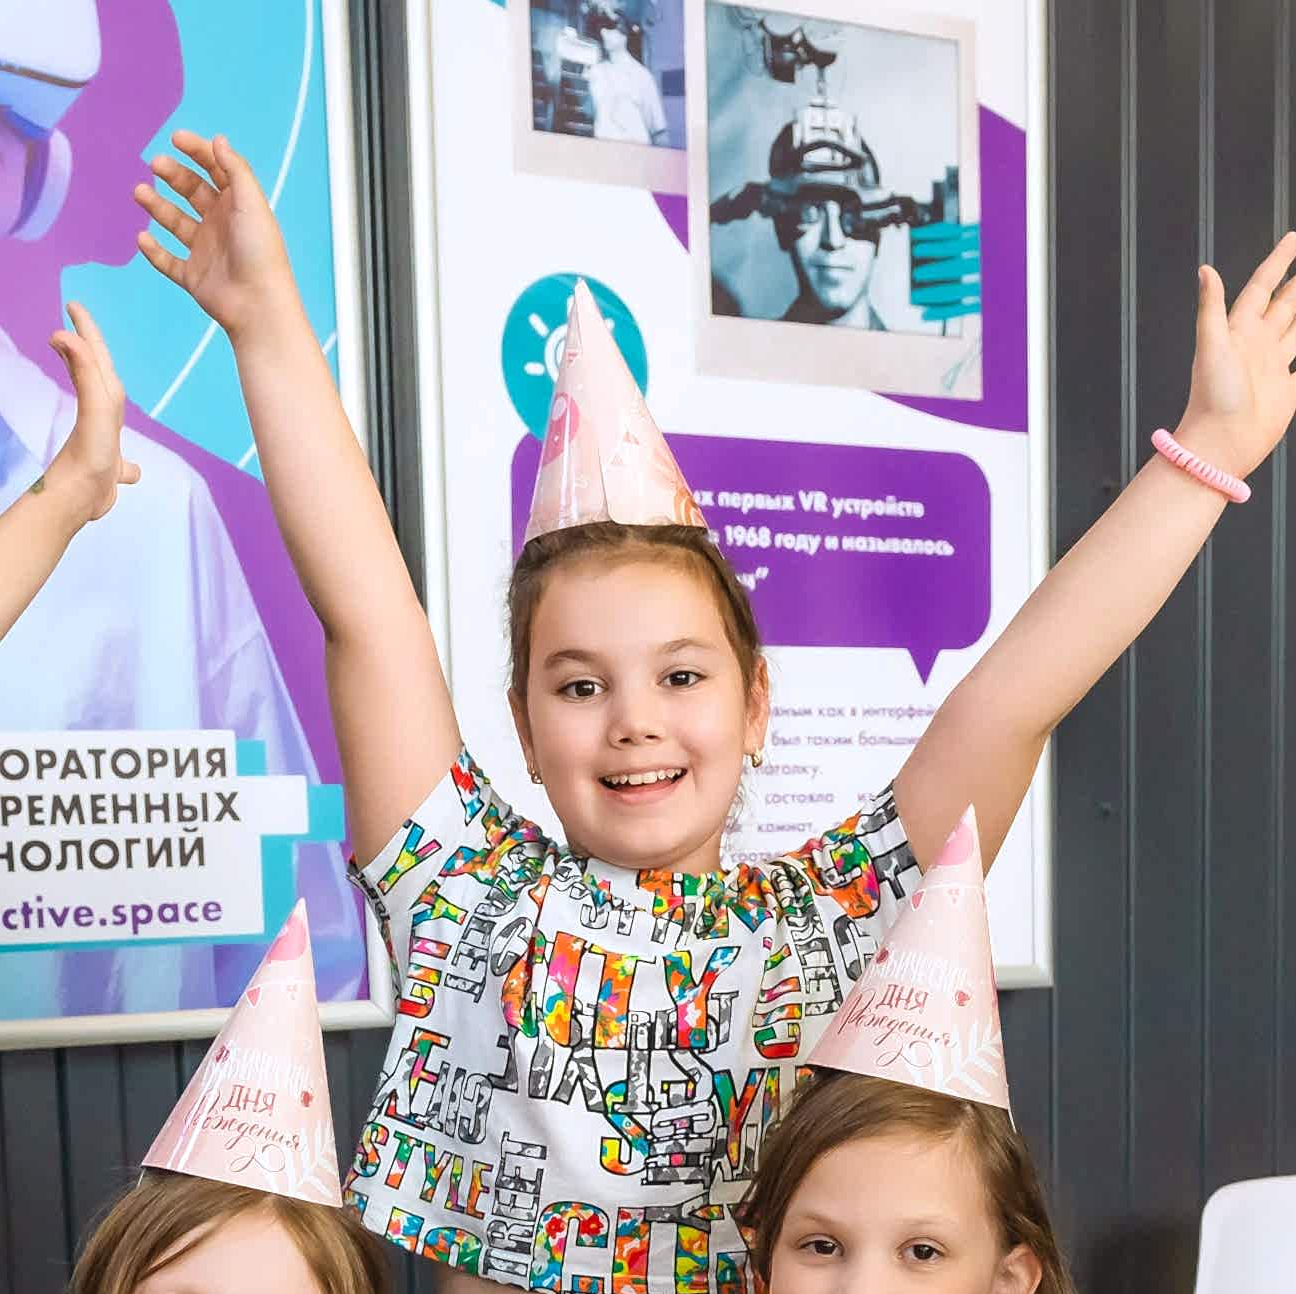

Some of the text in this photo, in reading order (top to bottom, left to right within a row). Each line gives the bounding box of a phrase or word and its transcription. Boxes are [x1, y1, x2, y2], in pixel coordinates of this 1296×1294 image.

[798, 489, 828, 513] VR
[831, 495, 925, 520] устройств
[724, 525, 771, 548] 1968
[774, 532, 821, 556] году
[824, 535, 839, 551] и
[842, 535, 955, 556] называлось
[875, 983, 930, 1015] ДНЯ
[221, 1084, 278, 1117] ДНЯ
[352, 1122, 495, 1221] STYLE
